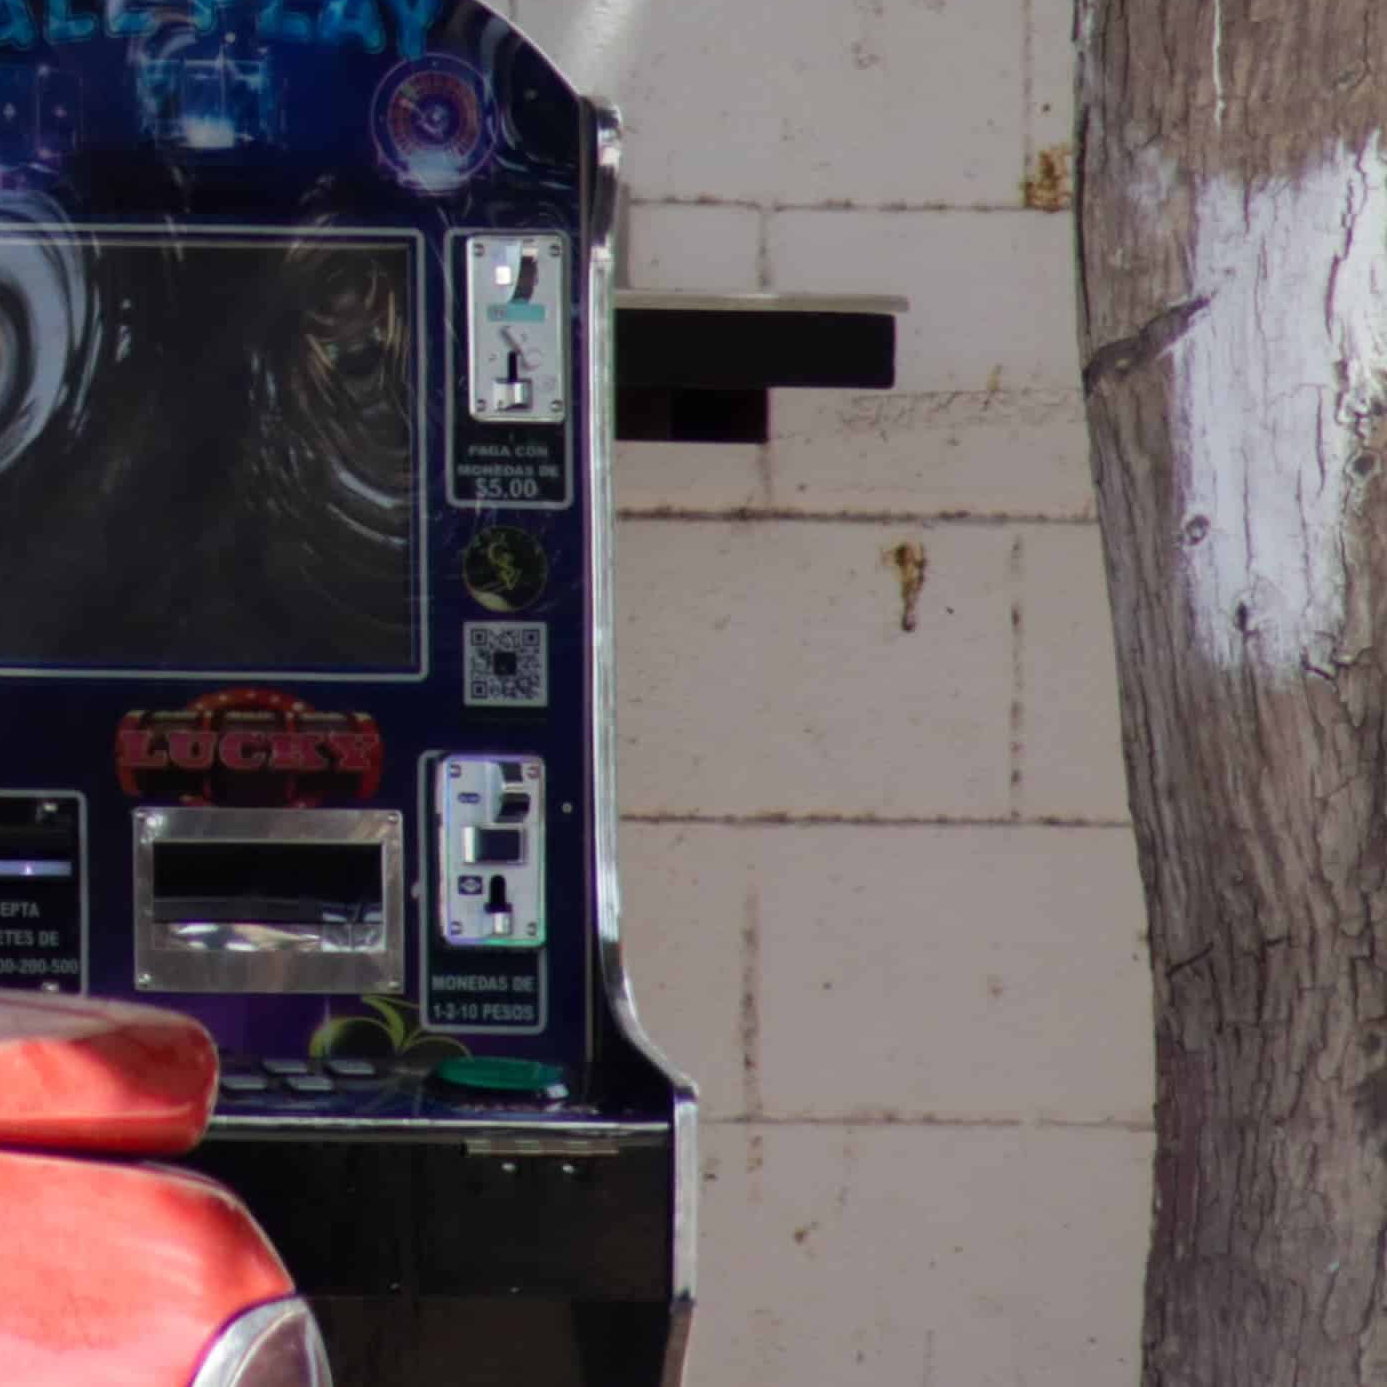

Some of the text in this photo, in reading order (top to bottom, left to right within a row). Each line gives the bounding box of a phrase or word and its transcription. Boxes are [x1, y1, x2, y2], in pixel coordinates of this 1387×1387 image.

[475, 477, 539, 499] $5.00
[118, 729, 382, 773] LUCKY
[39, 930, 60, 948] DE
[432, 975, 535, 993] MONEDAS DE
[482, 1005, 534, 1021] PESOS
